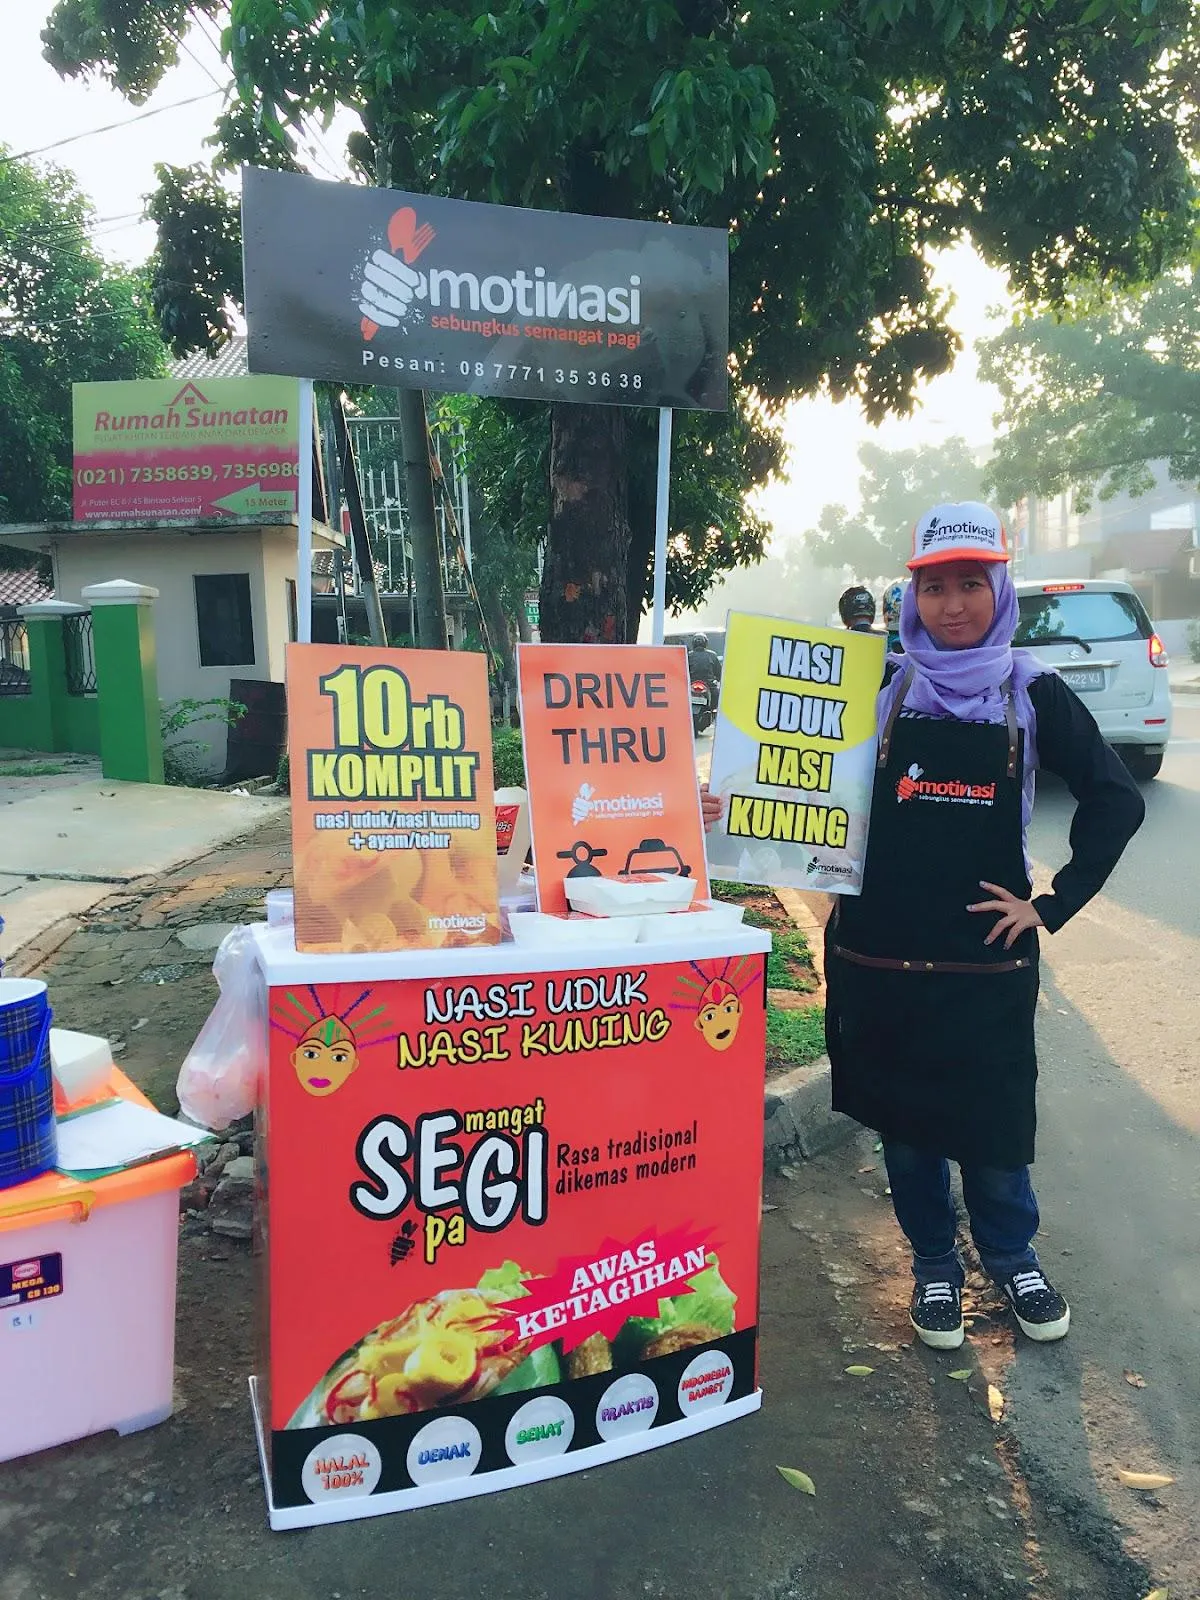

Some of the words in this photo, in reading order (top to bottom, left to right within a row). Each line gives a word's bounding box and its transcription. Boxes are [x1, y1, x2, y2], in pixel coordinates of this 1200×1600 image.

[431, 313, 520, 338] sebungkus
[523, 323, 604, 346] semangat
[606, 331, 641, 350] pagi
[361, 350, 446, 374] Pesan:
[459, 360, 485, 376] 08
[94, 407, 181, 431] Rumah
[184, 407, 289, 428] Sunatan
[77, 468, 125, 487] (021)
[130, 464, 218, 483] 7358639,
[258, 497, 288, 507] Meter
[767, 634, 845, 687] NASI
[319, 663, 466, 751] 10rb
[542, 672, 669, 709] DRIVE
[756, 687, 848, 741] UDUK
[551, 727, 667, 764] THRU
[306, 749, 481, 801] KOMPLIT
[755, 742, 834, 793] NASI
[315, 810, 351, 830] nasi
[351, 810, 430, 830] uduk/nasi
[429, 811, 481, 831] kuning
[726, 793, 850, 849] KUNING
[424, 980, 536, 1024] NASI
[546, 972, 649, 1015] UDUK
[396, 1025, 510, 1070] NASI
[520, 1008, 672, 1058] KUNING
[463, 1097, 546, 1135] mangat
[556, 1142, 601, 1169] Rasa
[605, 1119, 698, 1161] tradisional
[350, 1108, 549, 1233] SEGI
[555, 1167, 628, 1196] dikemas
[635, 1148, 696, 1181] modern
[423, 1211, 467, 1264] pa
[12, 1276, 44, 1291] MEGA
[569, 1240, 657, 1295] AWAS
[515, 1245, 706, 1340] KETAGIHAN
[680, 1366, 732, 1392] INDONESIA
[687, 1381, 726, 1403] BANGET
[600, 1396, 655, 1423] PRAKTIS
[515, 1419, 565, 1446] SEHAT
[313, 1450, 371, 1475] HALAL
[320, 1470, 364, 1491] 100%
